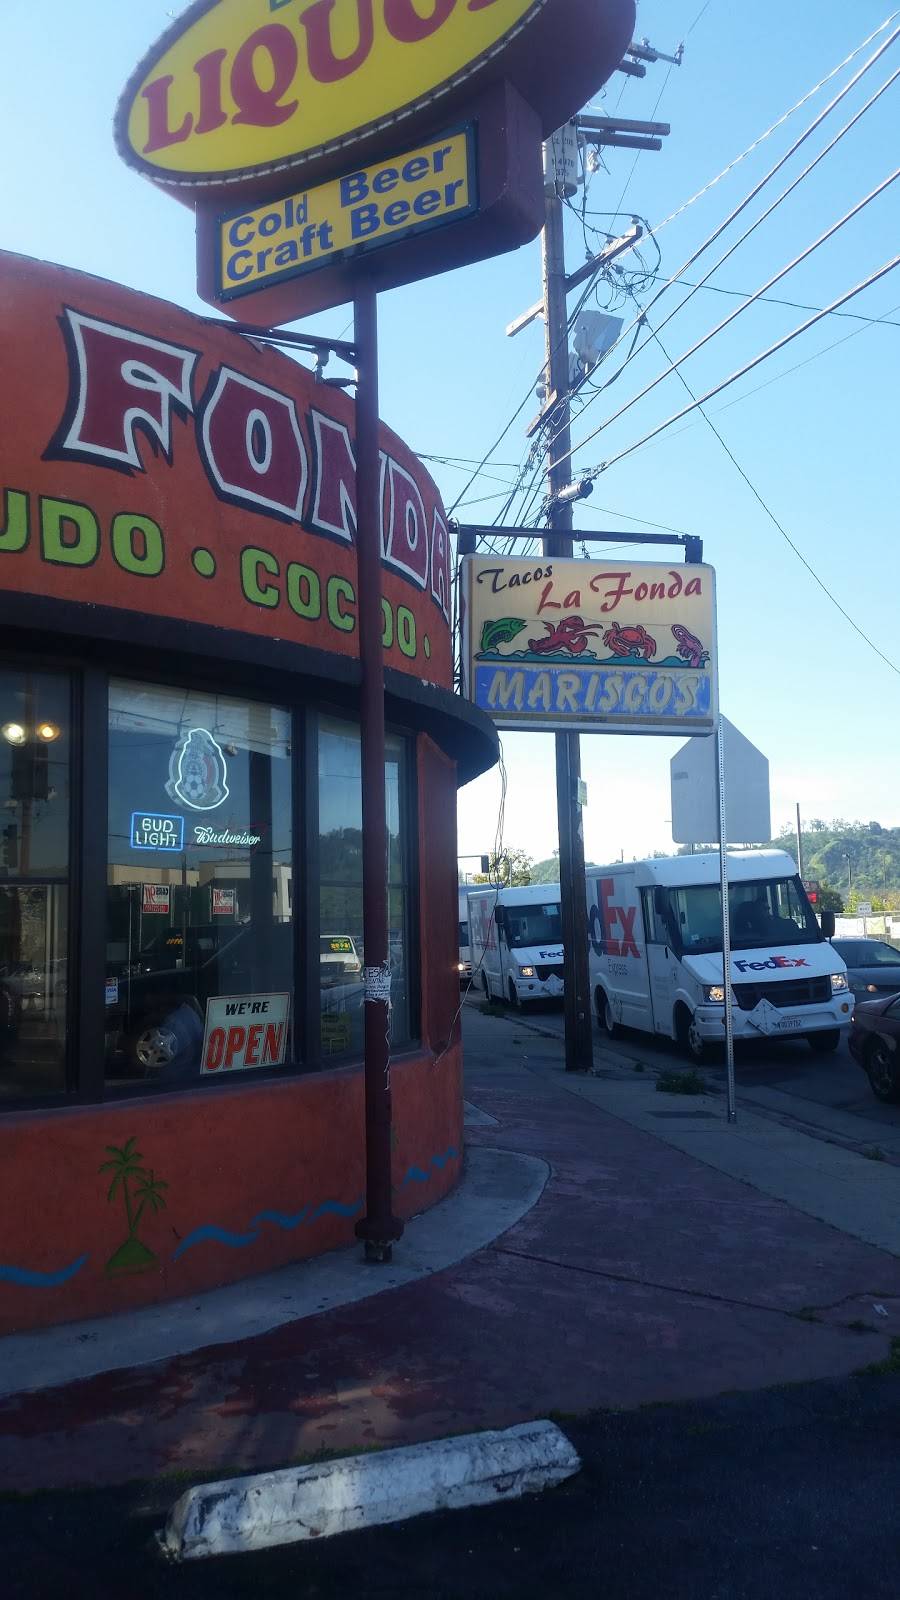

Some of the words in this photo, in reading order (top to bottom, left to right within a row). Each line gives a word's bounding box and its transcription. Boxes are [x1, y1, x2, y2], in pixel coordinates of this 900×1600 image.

[142, 0, 499, 154] LIQUO
[229, 193, 308, 248] Cold
[340, 146, 452, 208] Beer
[227, 219, 333, 281] Craft
[351, 179, 464, 240] Beer
[52, 304, 449, 624] FONDA
[477, 565, 552, 593] Tacos
[536, 581, 581, 614] La
[590, 571, 702, 612] Fonda
[487, 670, 701, 714] MARISCOS
[136, 831, 178, 847] LIGHT
[194, 826, 260, 845] Budweiser
[733, 956, 812, 972] FedEx
[225, 1001, 269, 1015] WE'RE
[206, 1022, 285, 1071] OPEN
